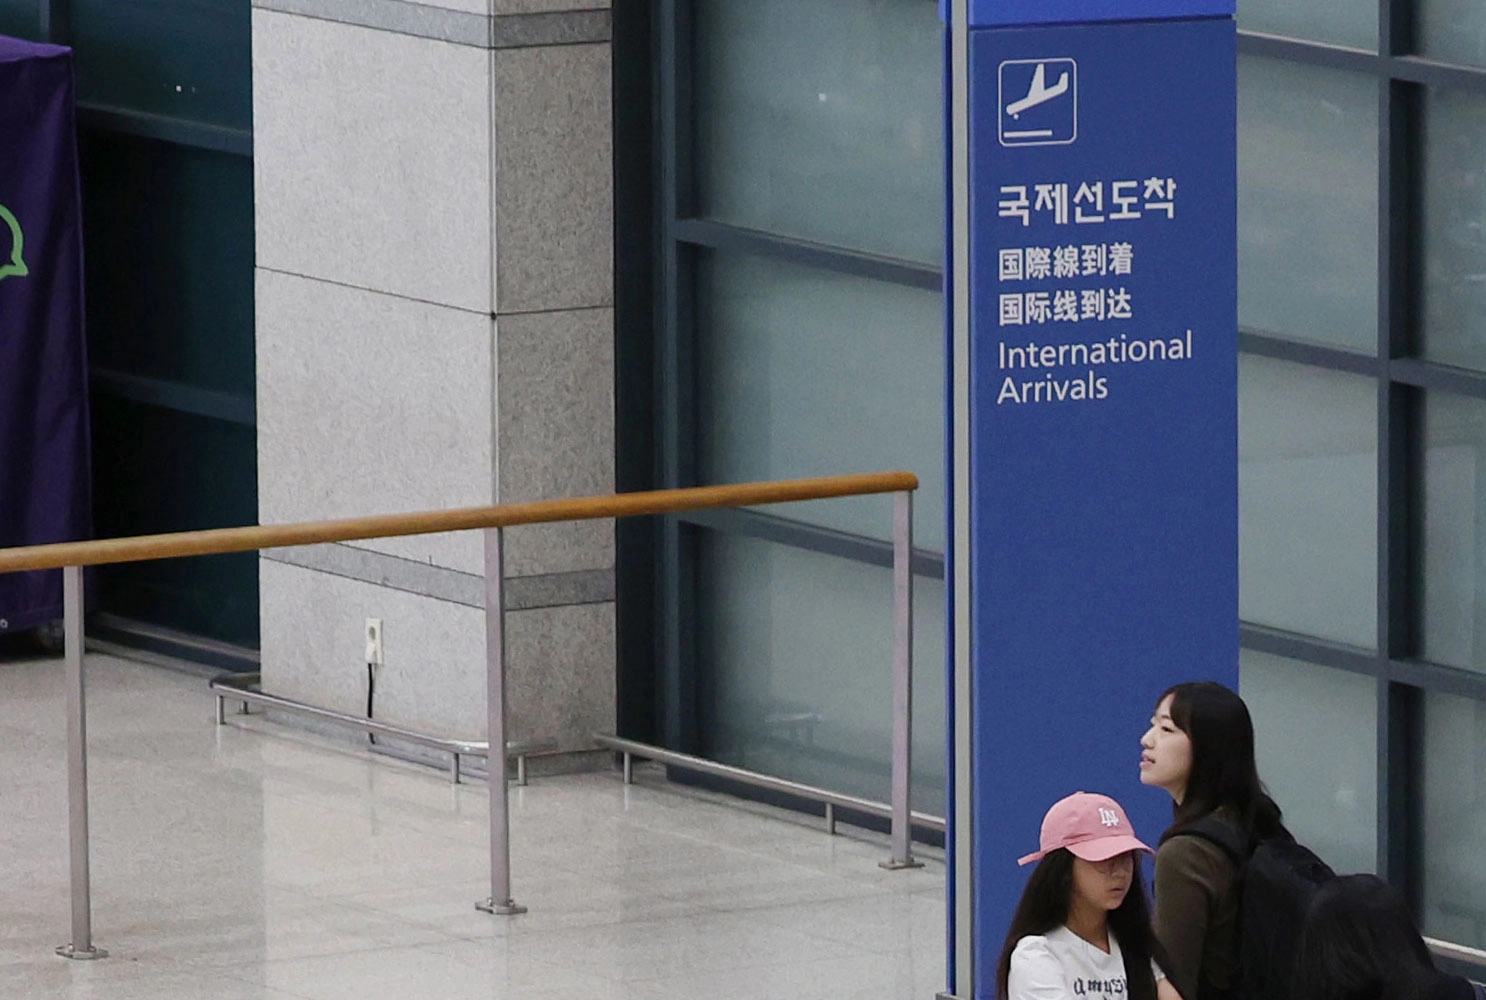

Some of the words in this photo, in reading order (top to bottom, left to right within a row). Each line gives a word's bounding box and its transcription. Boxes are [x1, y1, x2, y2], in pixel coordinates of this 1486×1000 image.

[998, 177, 1177, 226] 국제선도착
[999, 242, 1134, 282] 国際線到着
[999, 288, 1133, 326] 国际线到达
[999, 330, 1192, 369] International
[997, 370, 1109, 405] Arrivals
